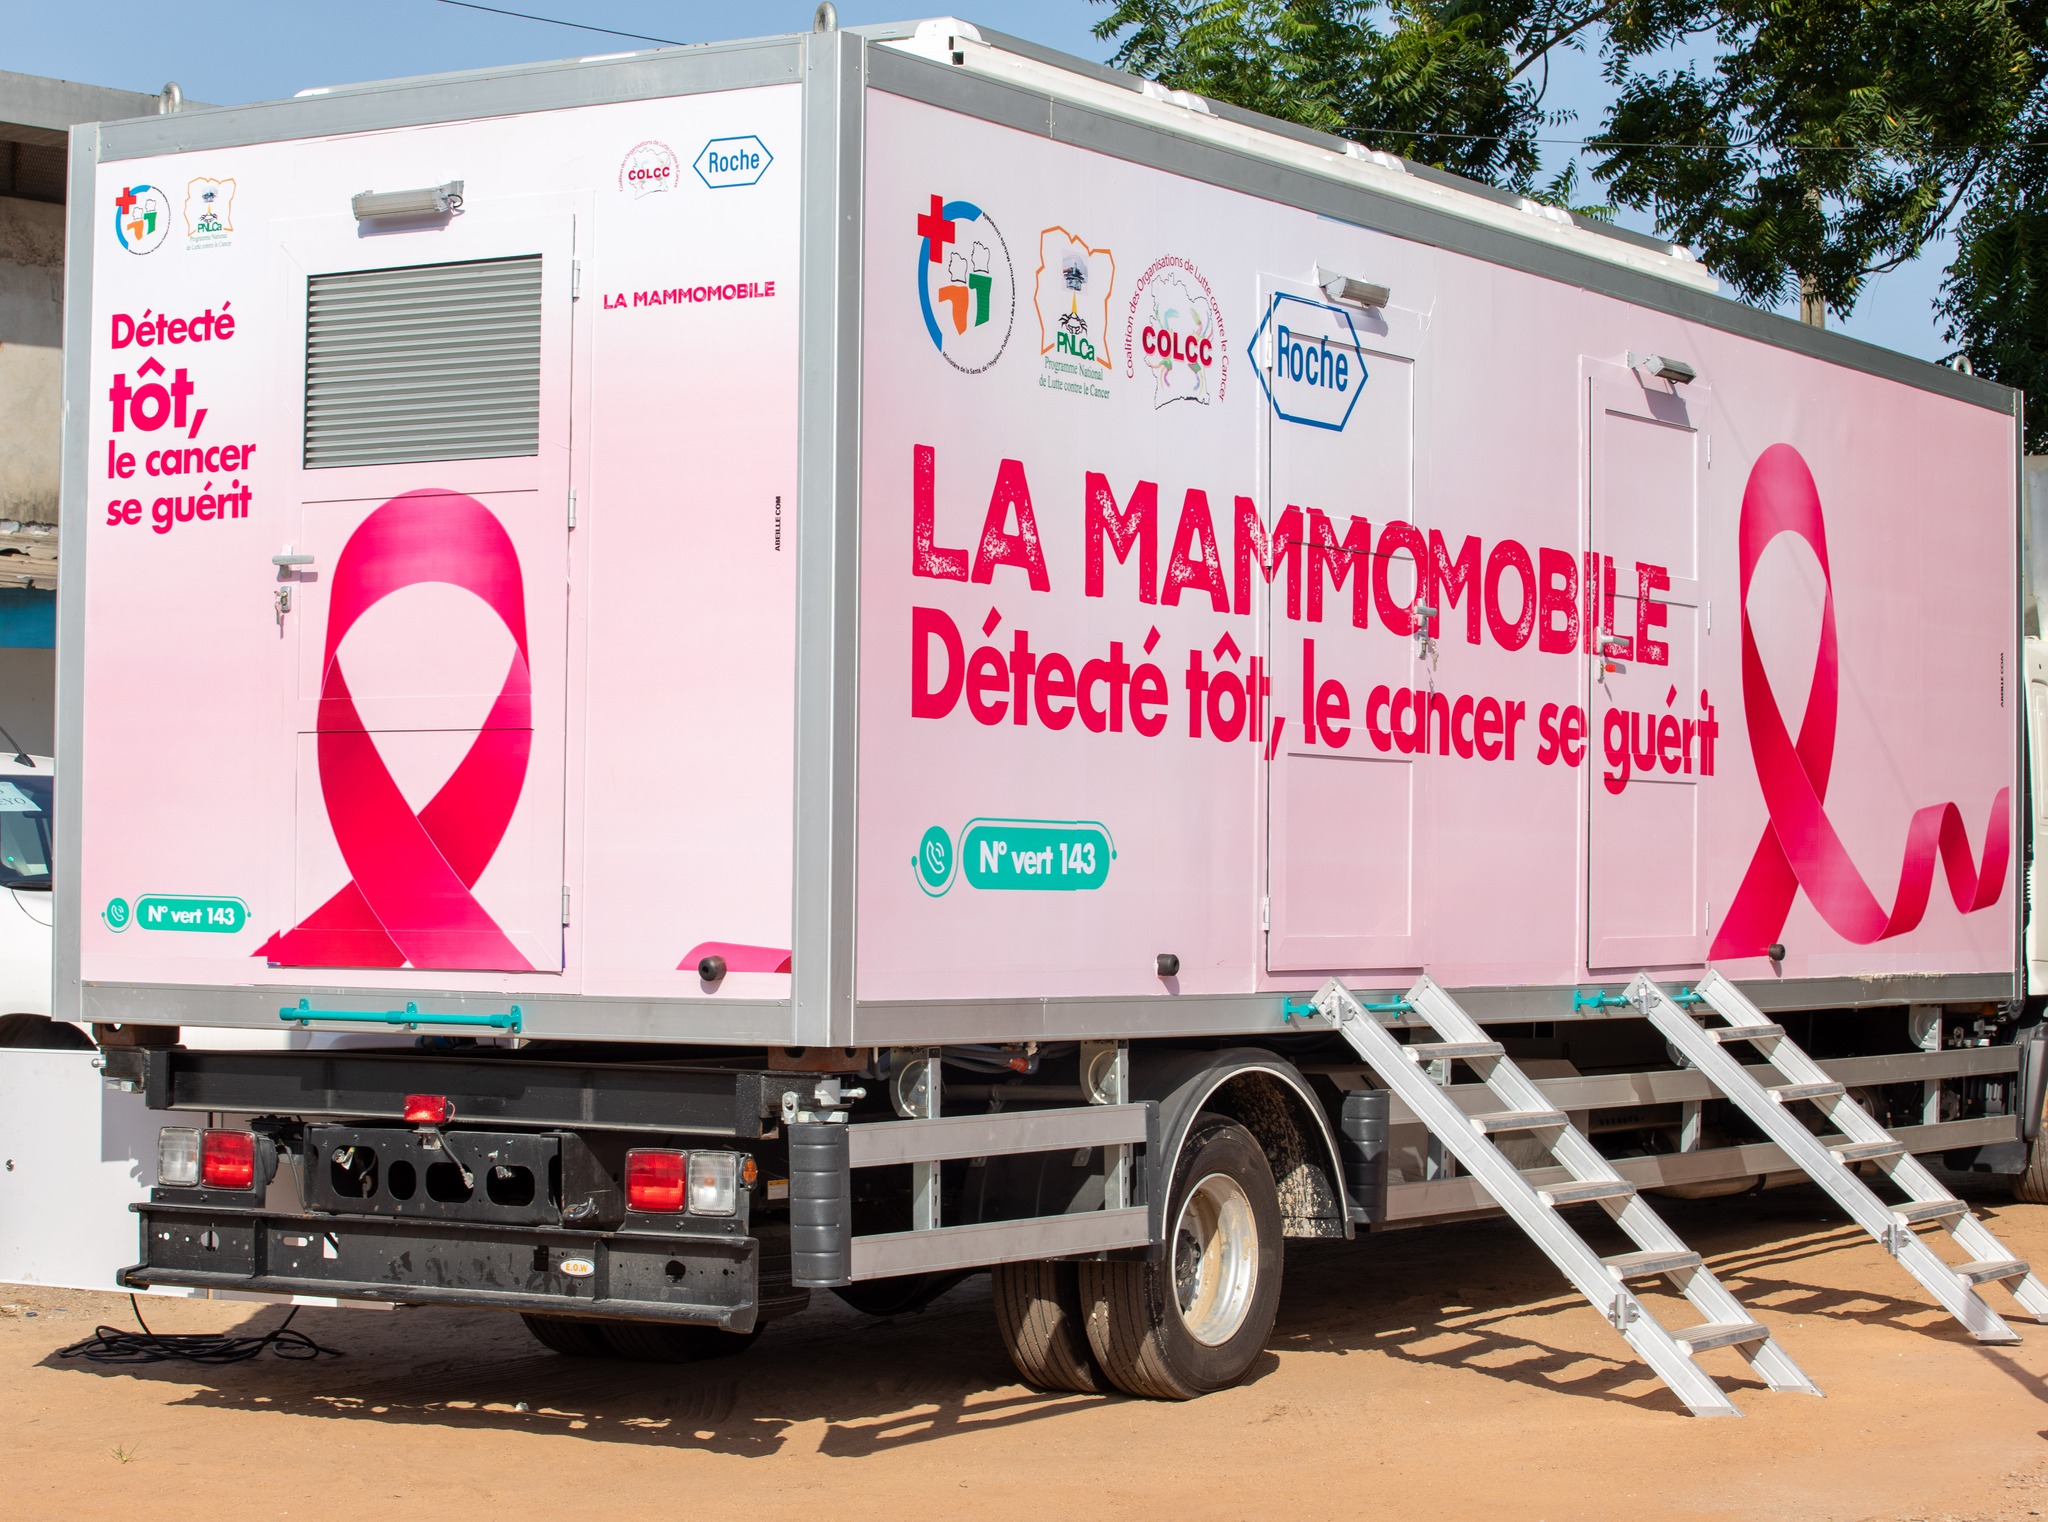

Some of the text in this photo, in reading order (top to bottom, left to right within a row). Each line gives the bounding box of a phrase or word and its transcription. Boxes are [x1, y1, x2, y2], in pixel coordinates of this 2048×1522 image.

[628, 166, 670, 181] COLCC
[709, 149, 759, 173] Roche
[198, 221, 222, 233] PNLCa
[604, 281, 775, 310] LA MAMMOMOBILE
[111, 301, 235, 349] Détecté
[1124, 253, 1230, 403] Coalition des Organisations de Lutte contre le Cancer
[1057, 331, 1095, 361] PNLCa
[1142, 325, 1213, 368] COLCC
[1277, 324, 1349, 392] Roche
[1044, 356, 1103, 381] Programme National
[109, 356, 208, 439] tôt,
[1039, 374, 1110, 399] de Lutte contre le Cancer
[108, 440, 256, 479] le cancer
[106, 479, 252, 534] se guérit
[912, 443, 1671, 667] LA MAMMOMOBILE
[911, 606, 1719, 796] Détecté tôt, le cancer se guérit
[1011, 846, 1054, 875] vert
[1059, 842, 1097, 875] 143
[171, 908, 202, 924] vert
[207, 907, 235, 925] 143
[565, 1263, 588, 1273] E.O.W
